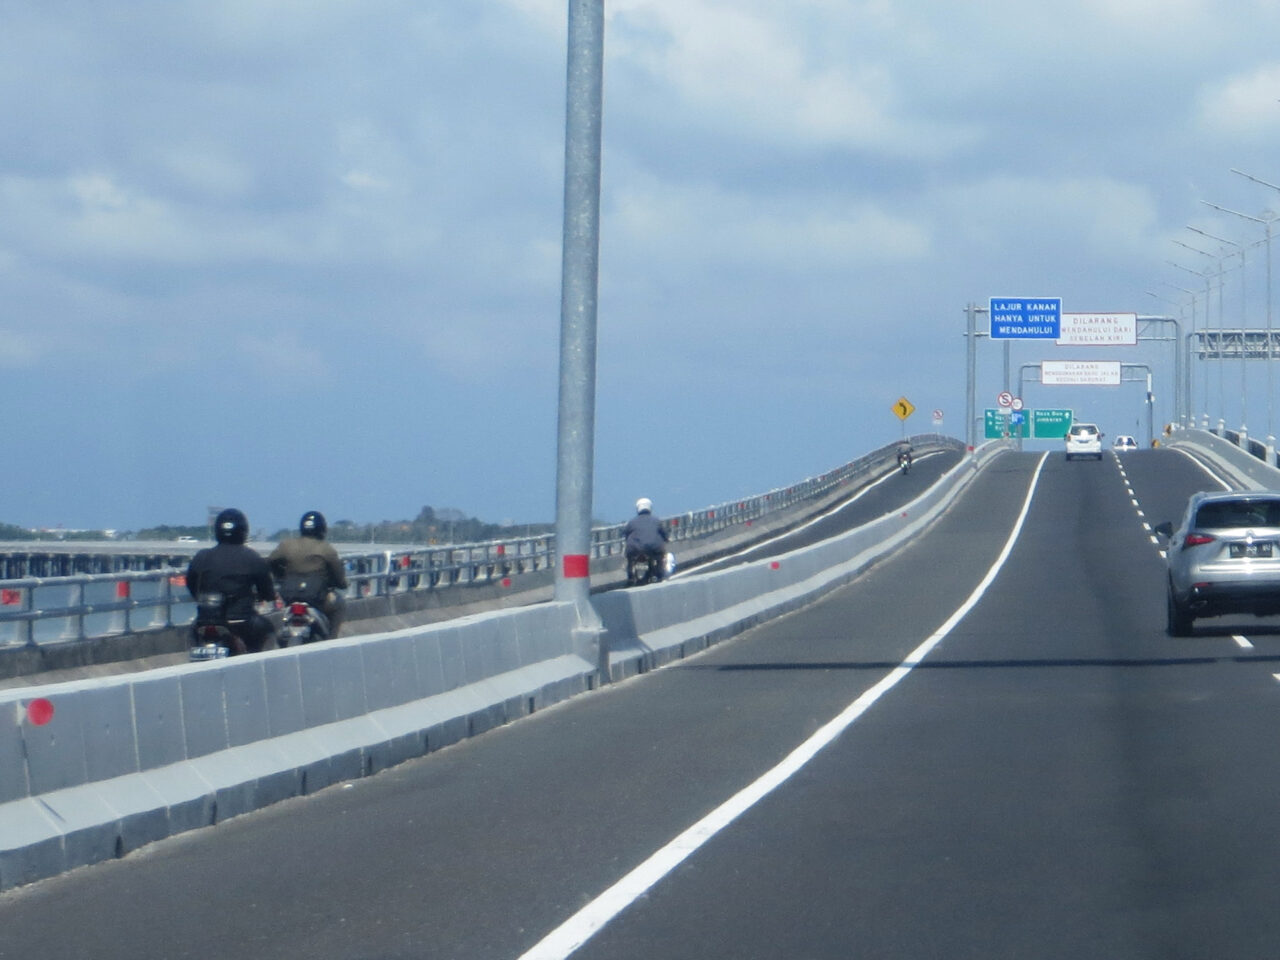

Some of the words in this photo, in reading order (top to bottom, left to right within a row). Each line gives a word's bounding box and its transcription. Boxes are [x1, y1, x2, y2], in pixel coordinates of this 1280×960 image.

[994, 303, 1022, 311] LAJUR
[1026, 303, 1057, 311] KANAN
[994, 314, 1023, 322] HANYA
[1028, 314, 1056, 322] UNTUK
[999, 326, 1053, 334] MENDAHULUI
